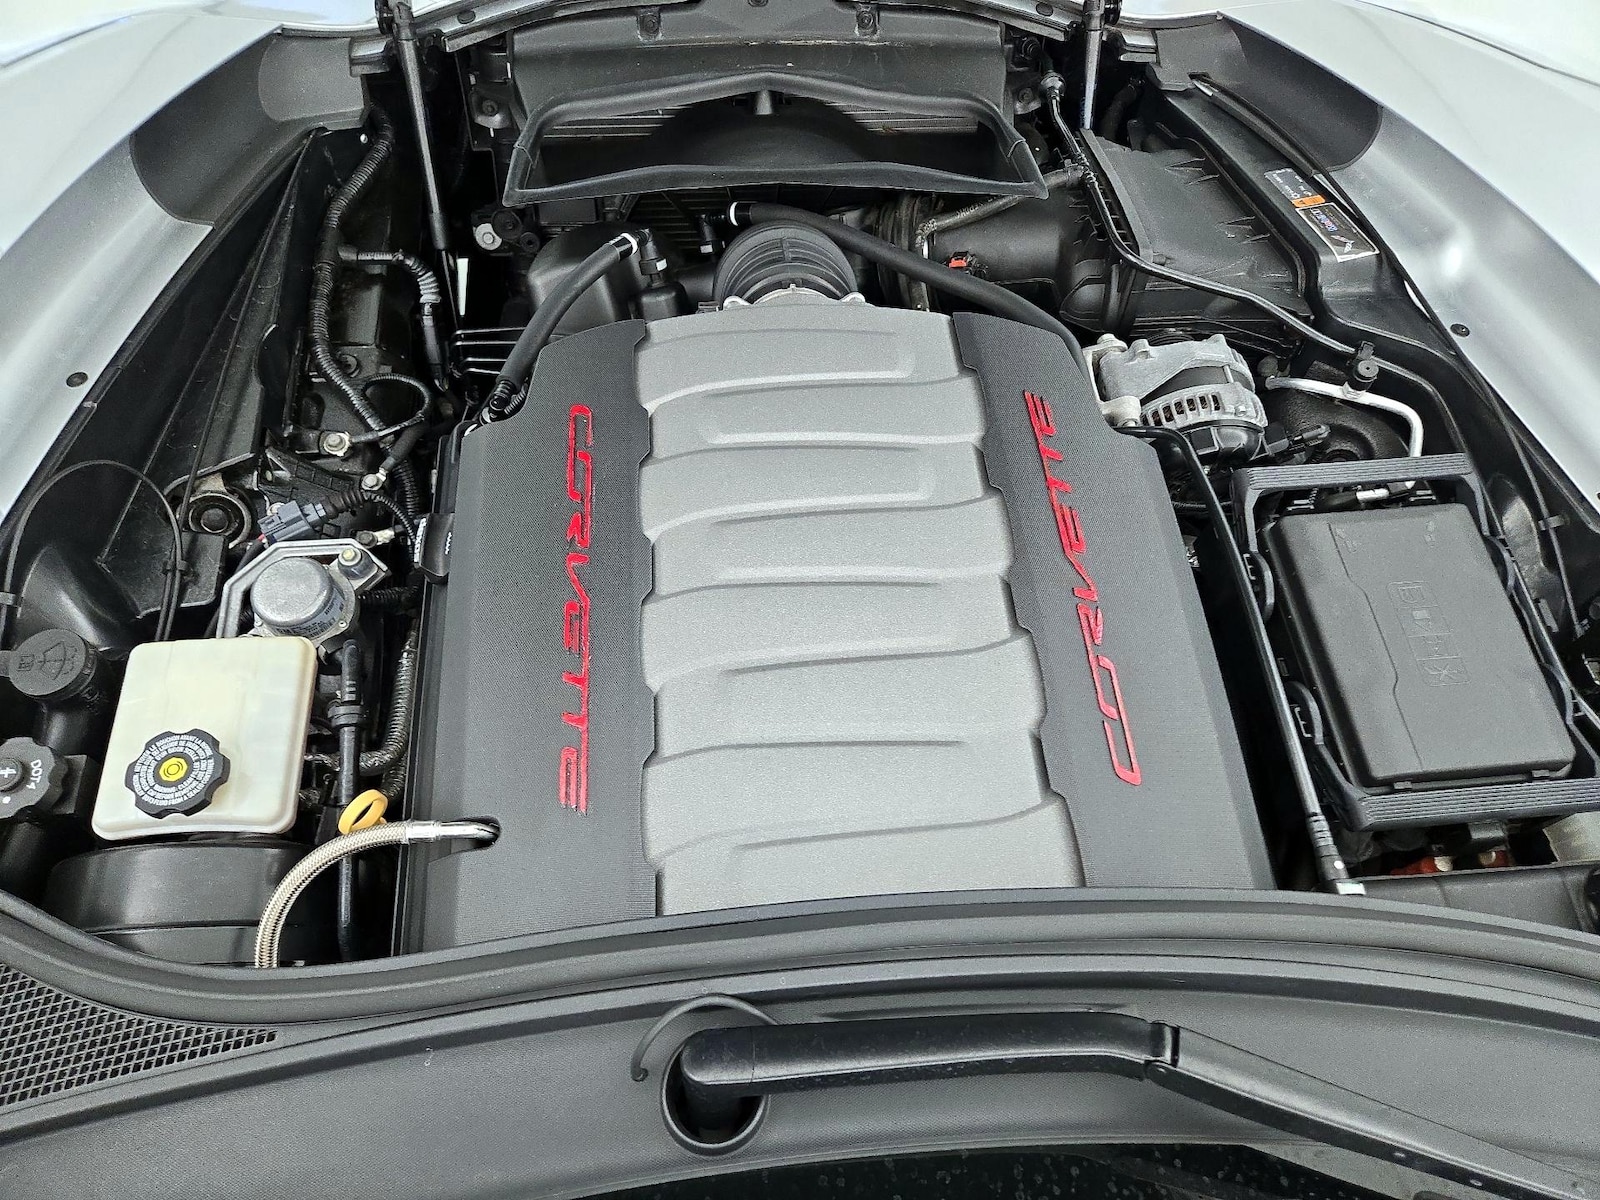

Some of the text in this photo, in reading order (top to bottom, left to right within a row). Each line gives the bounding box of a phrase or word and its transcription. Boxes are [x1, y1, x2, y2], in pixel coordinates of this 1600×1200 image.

[26, 759, 42, 790] DOT 4
[558, 404, 593, 815] CORVETTE
[1023, 389, 1142, 787] CORVETTE
